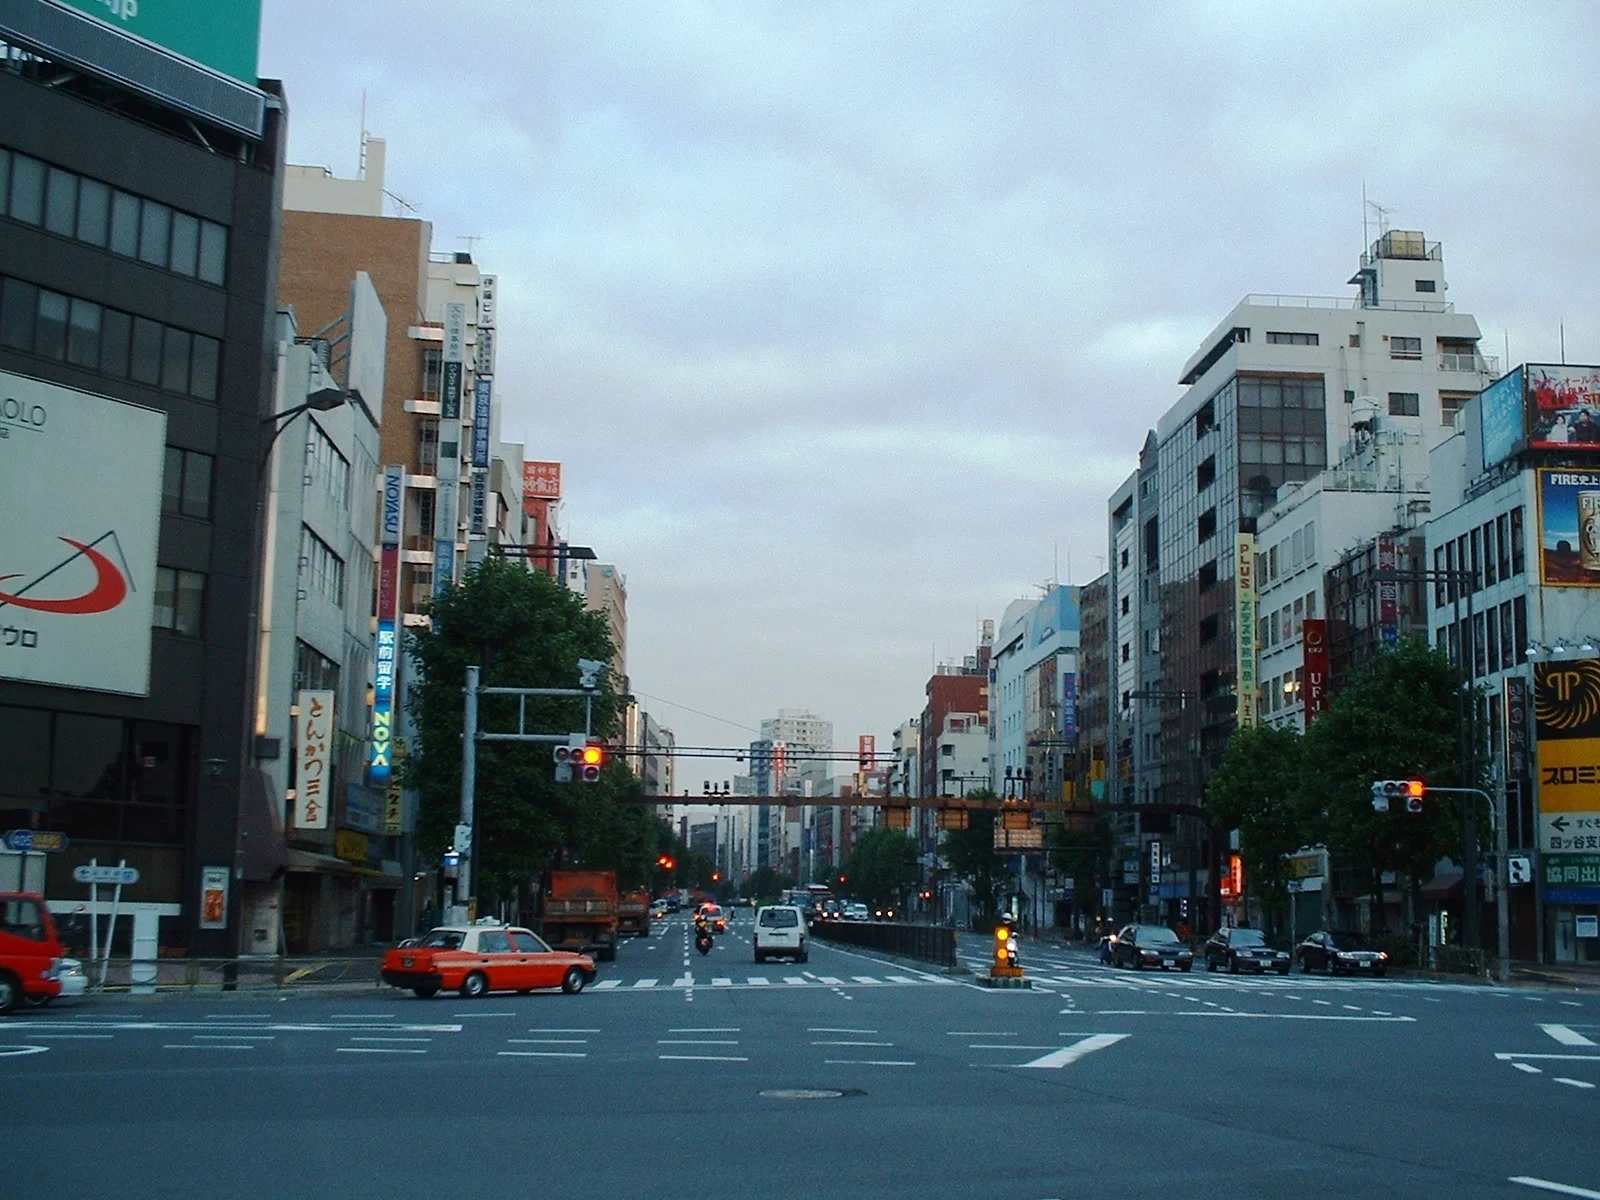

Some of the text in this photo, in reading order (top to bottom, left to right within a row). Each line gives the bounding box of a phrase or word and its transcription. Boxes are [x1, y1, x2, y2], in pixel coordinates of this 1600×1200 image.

[0, 398, 47, 426] OLO
[1550, 474, 1600, 486] FIRE史上
[385, 474, 399, 534] NOYASU
[1240, 544, 1251, 590] PLUS
[376, 630, 395, 690] 駅前留学
[303, 696, 325, 824] とんかつ三金
[371, 711, 391, 767] NOVA
[1550, 836, 1600, 849] 四ツ谷支
[1546, 866, 1600, 883] 協同出
